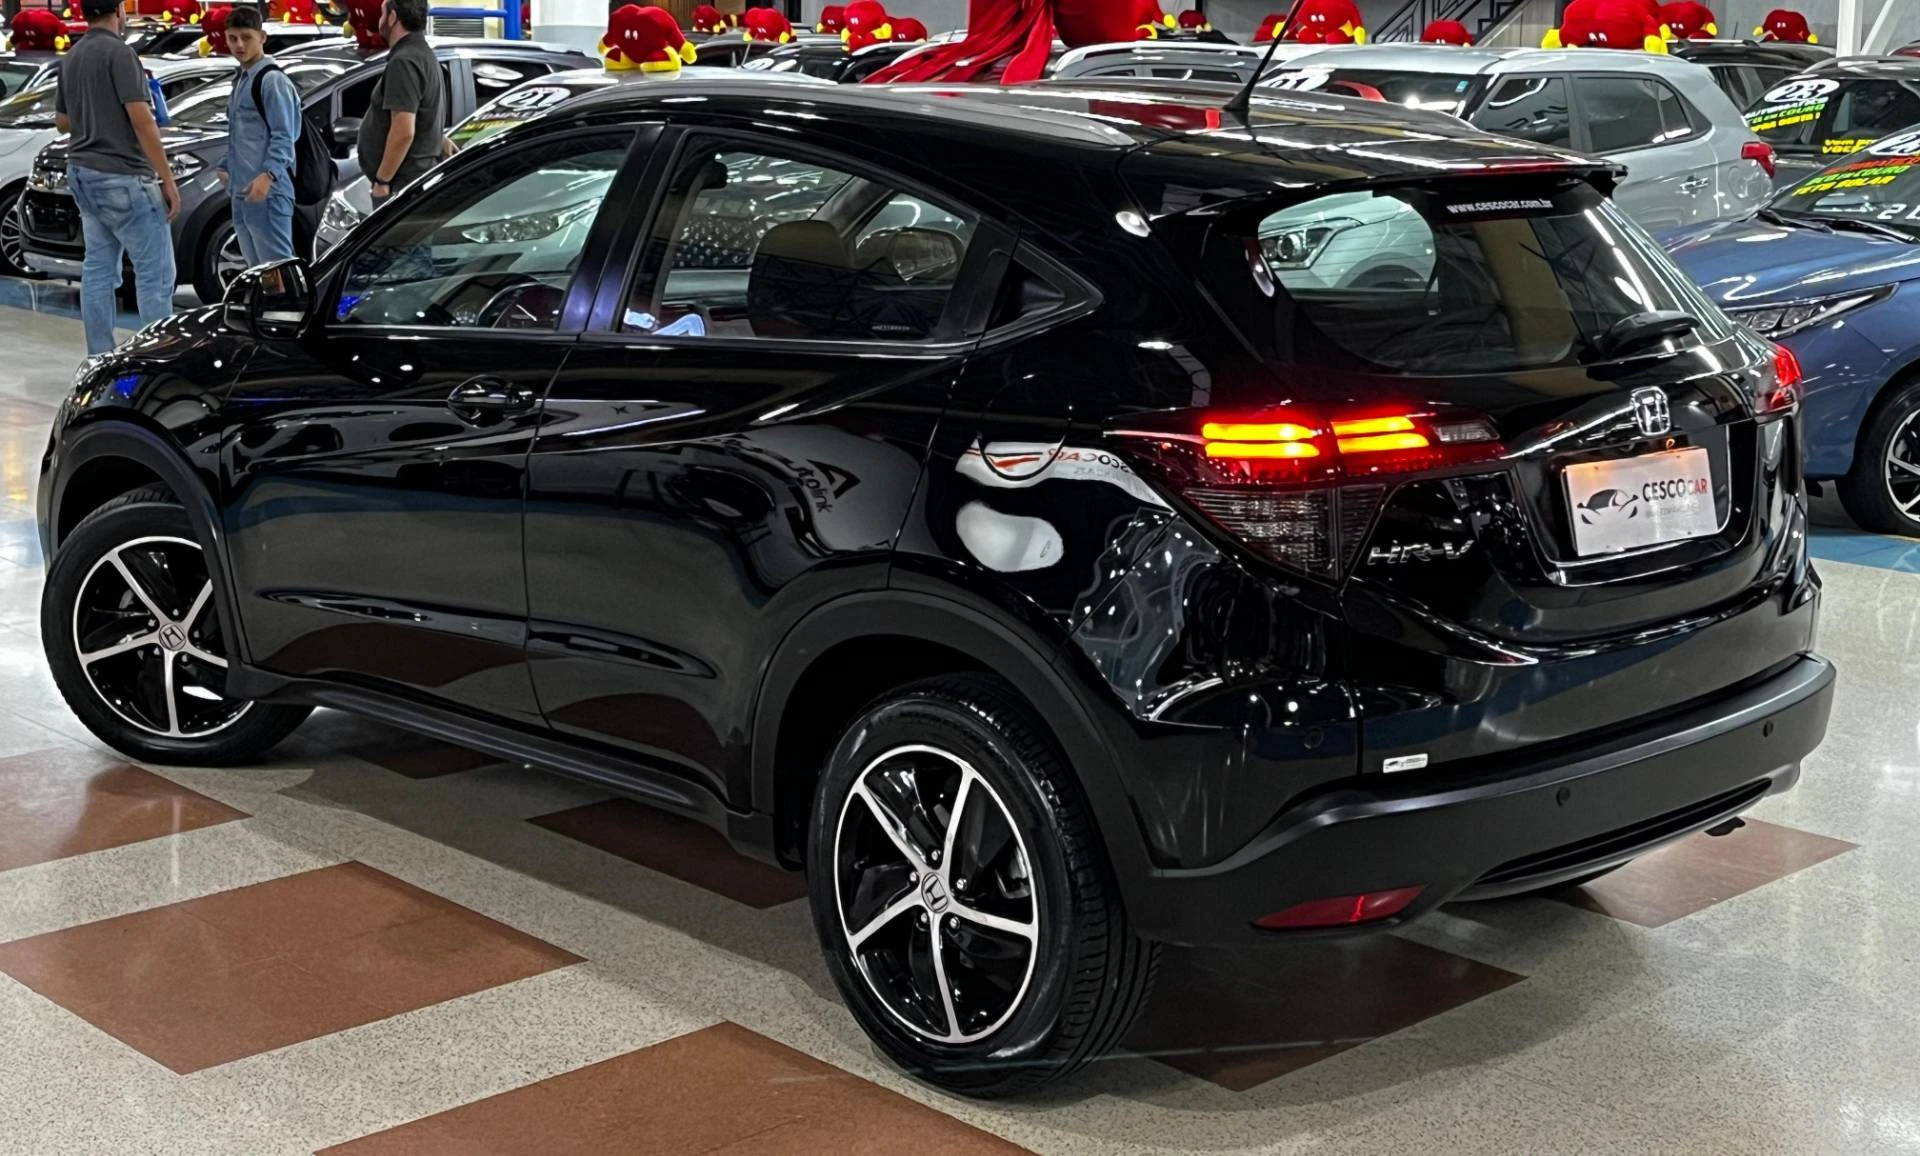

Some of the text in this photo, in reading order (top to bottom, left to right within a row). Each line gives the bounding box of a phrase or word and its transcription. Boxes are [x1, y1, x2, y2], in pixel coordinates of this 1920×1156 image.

[507, 90, 555, 107] 21
[1783, 82, 1827, 99] 23
[1643, 478, 1708, 502] CESCOCAR
[1367, 541, 1474, 565] HR-V
